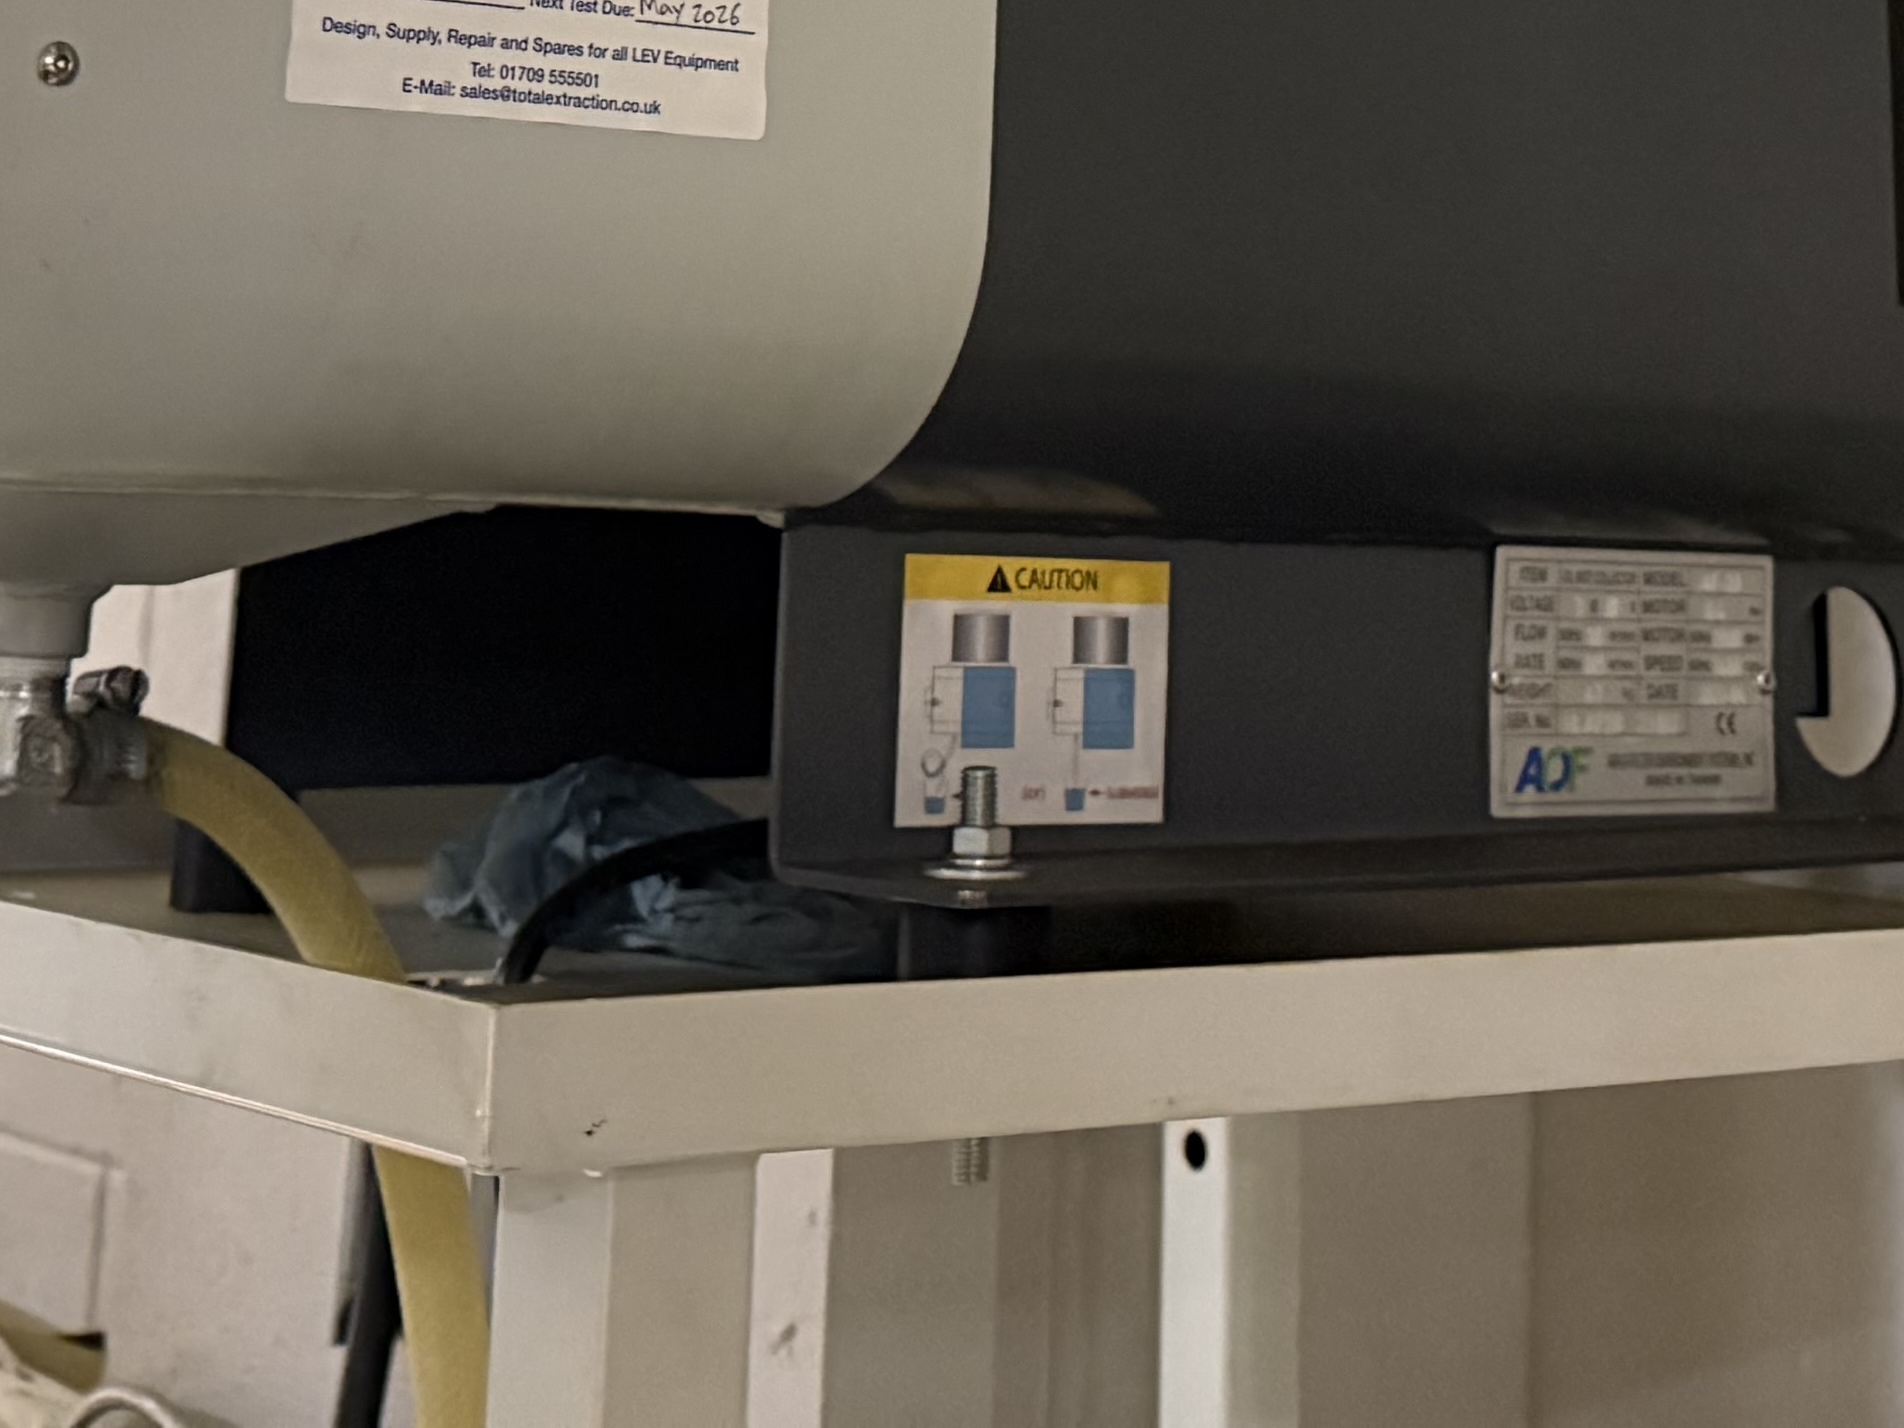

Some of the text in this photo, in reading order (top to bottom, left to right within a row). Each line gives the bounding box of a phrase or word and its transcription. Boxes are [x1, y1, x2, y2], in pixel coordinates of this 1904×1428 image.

[693, 3, 741, 26] 2026
[322, 18, 739, 75] Design, Supply, Repair and Spares for all LEV Equipment
[499, 65, 544, 84] 01709
[549, 68, 599, 89] 555501
[402, 78, 661, 116] E-Mail: sales@totalextraction.co.uk
[1015, 568, 1098, 591] CAUTION
[1514, 623, 1546, 639] FLOW
[1514, 653, 1544, 669] RATE
